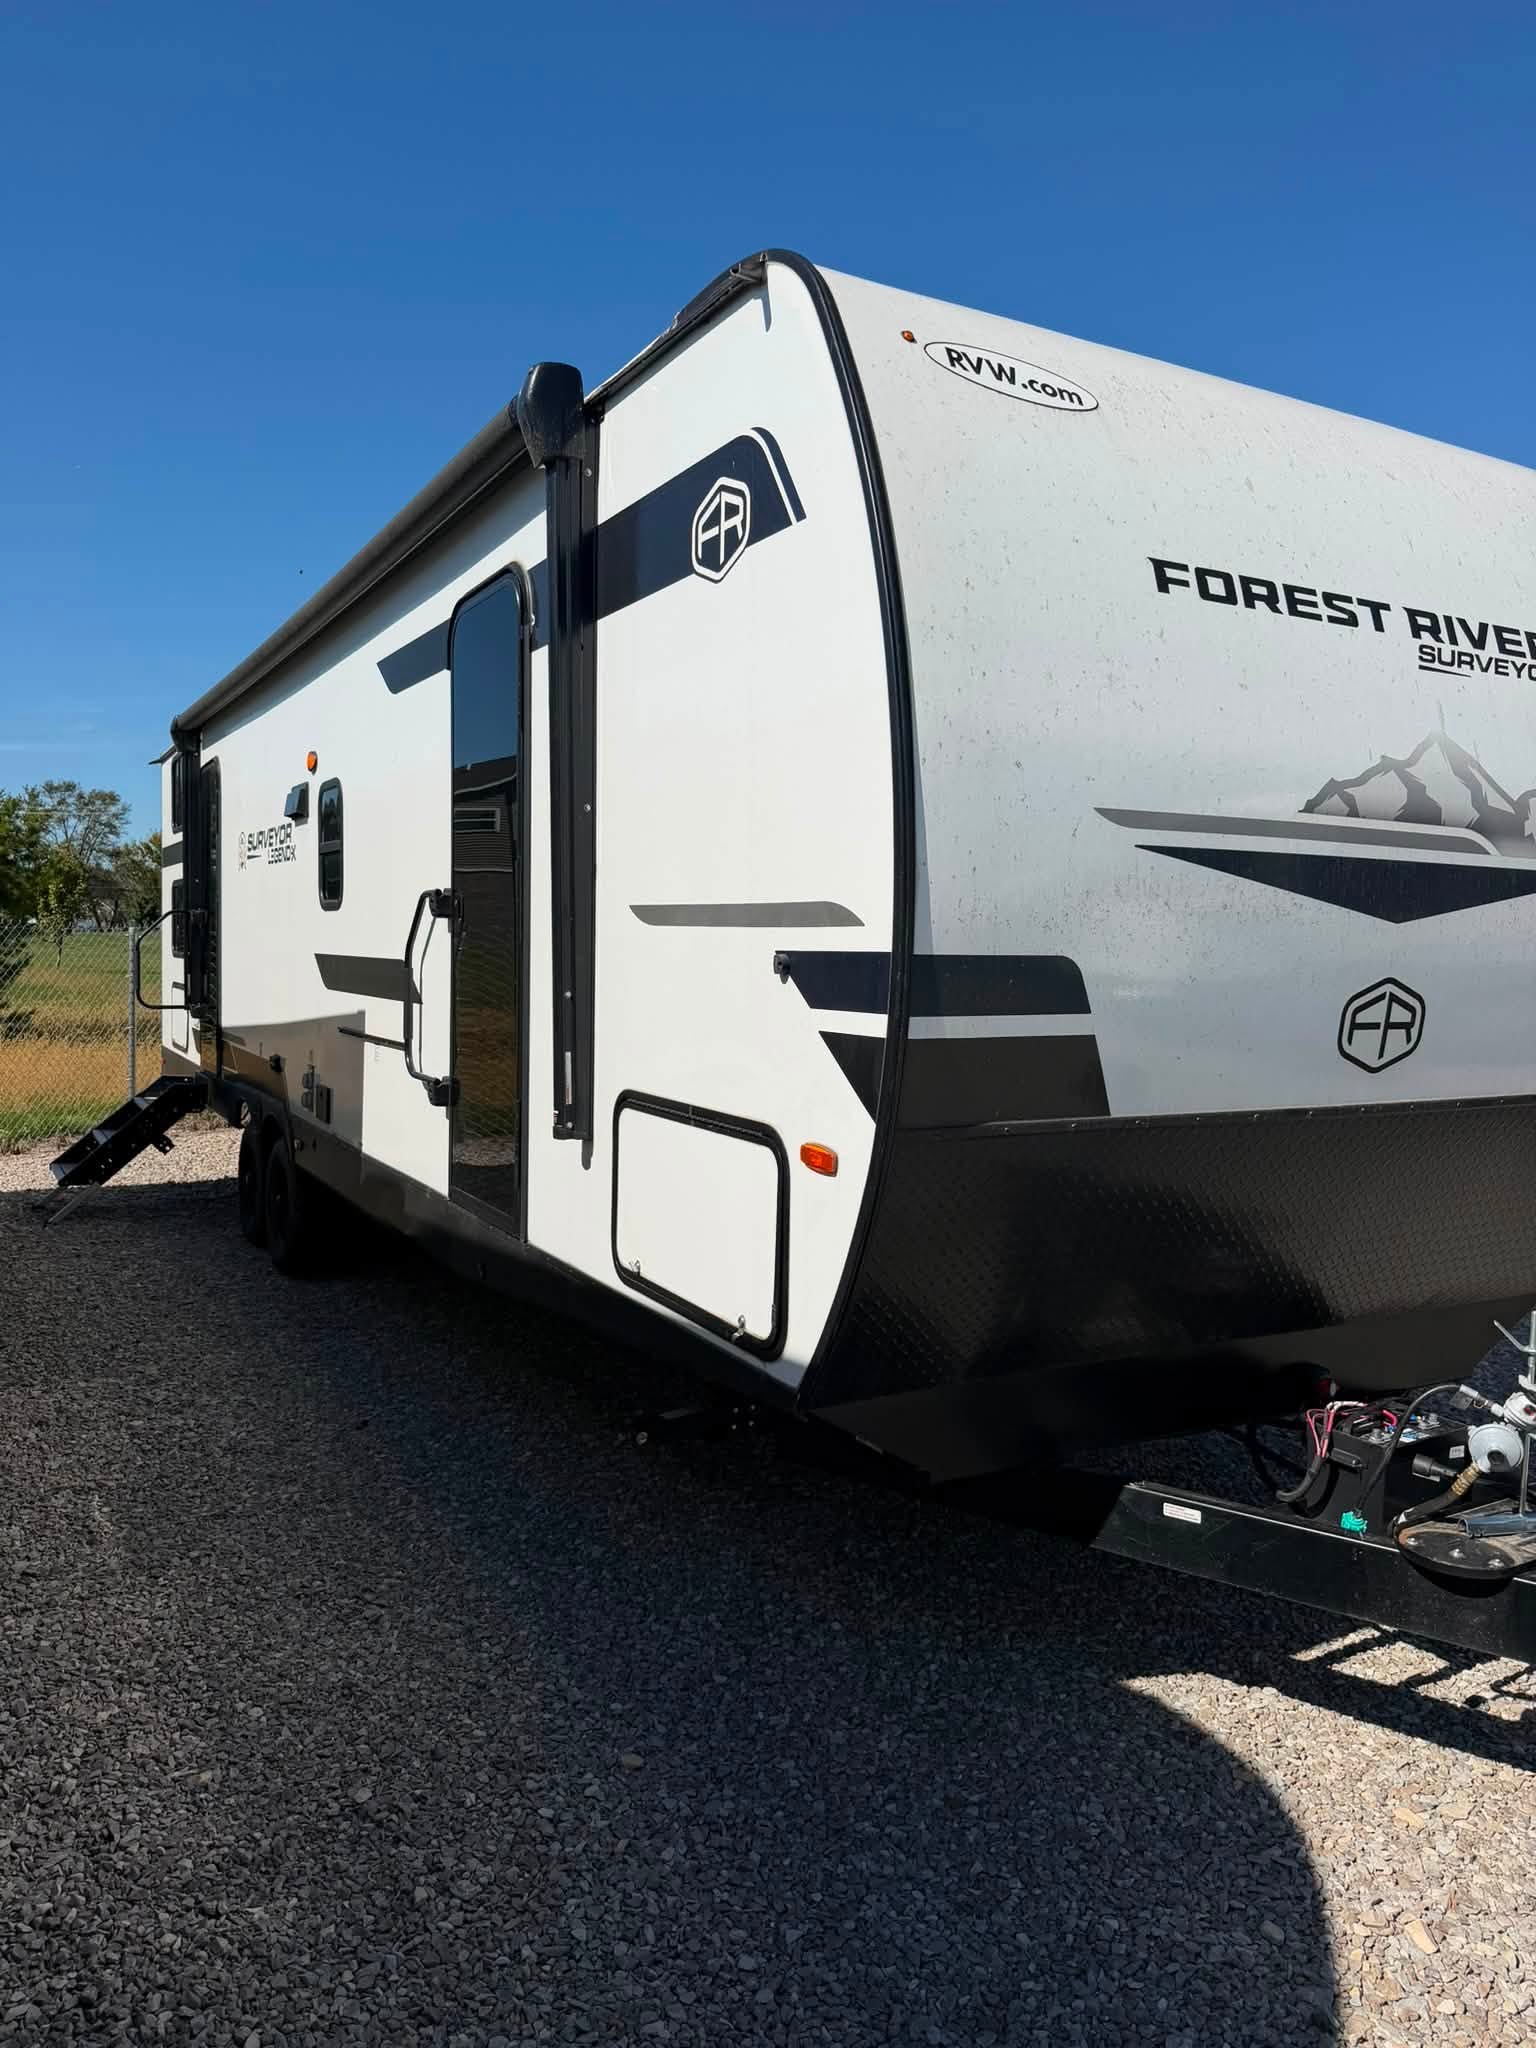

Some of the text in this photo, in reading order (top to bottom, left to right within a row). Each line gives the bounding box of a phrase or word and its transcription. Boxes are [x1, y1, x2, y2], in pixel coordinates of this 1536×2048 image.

[944, 346, 1085, 407] RVW.com
[1147, 556, 1392, 633] FOREST
[247, 822, 293, 852] SURVEYOR
